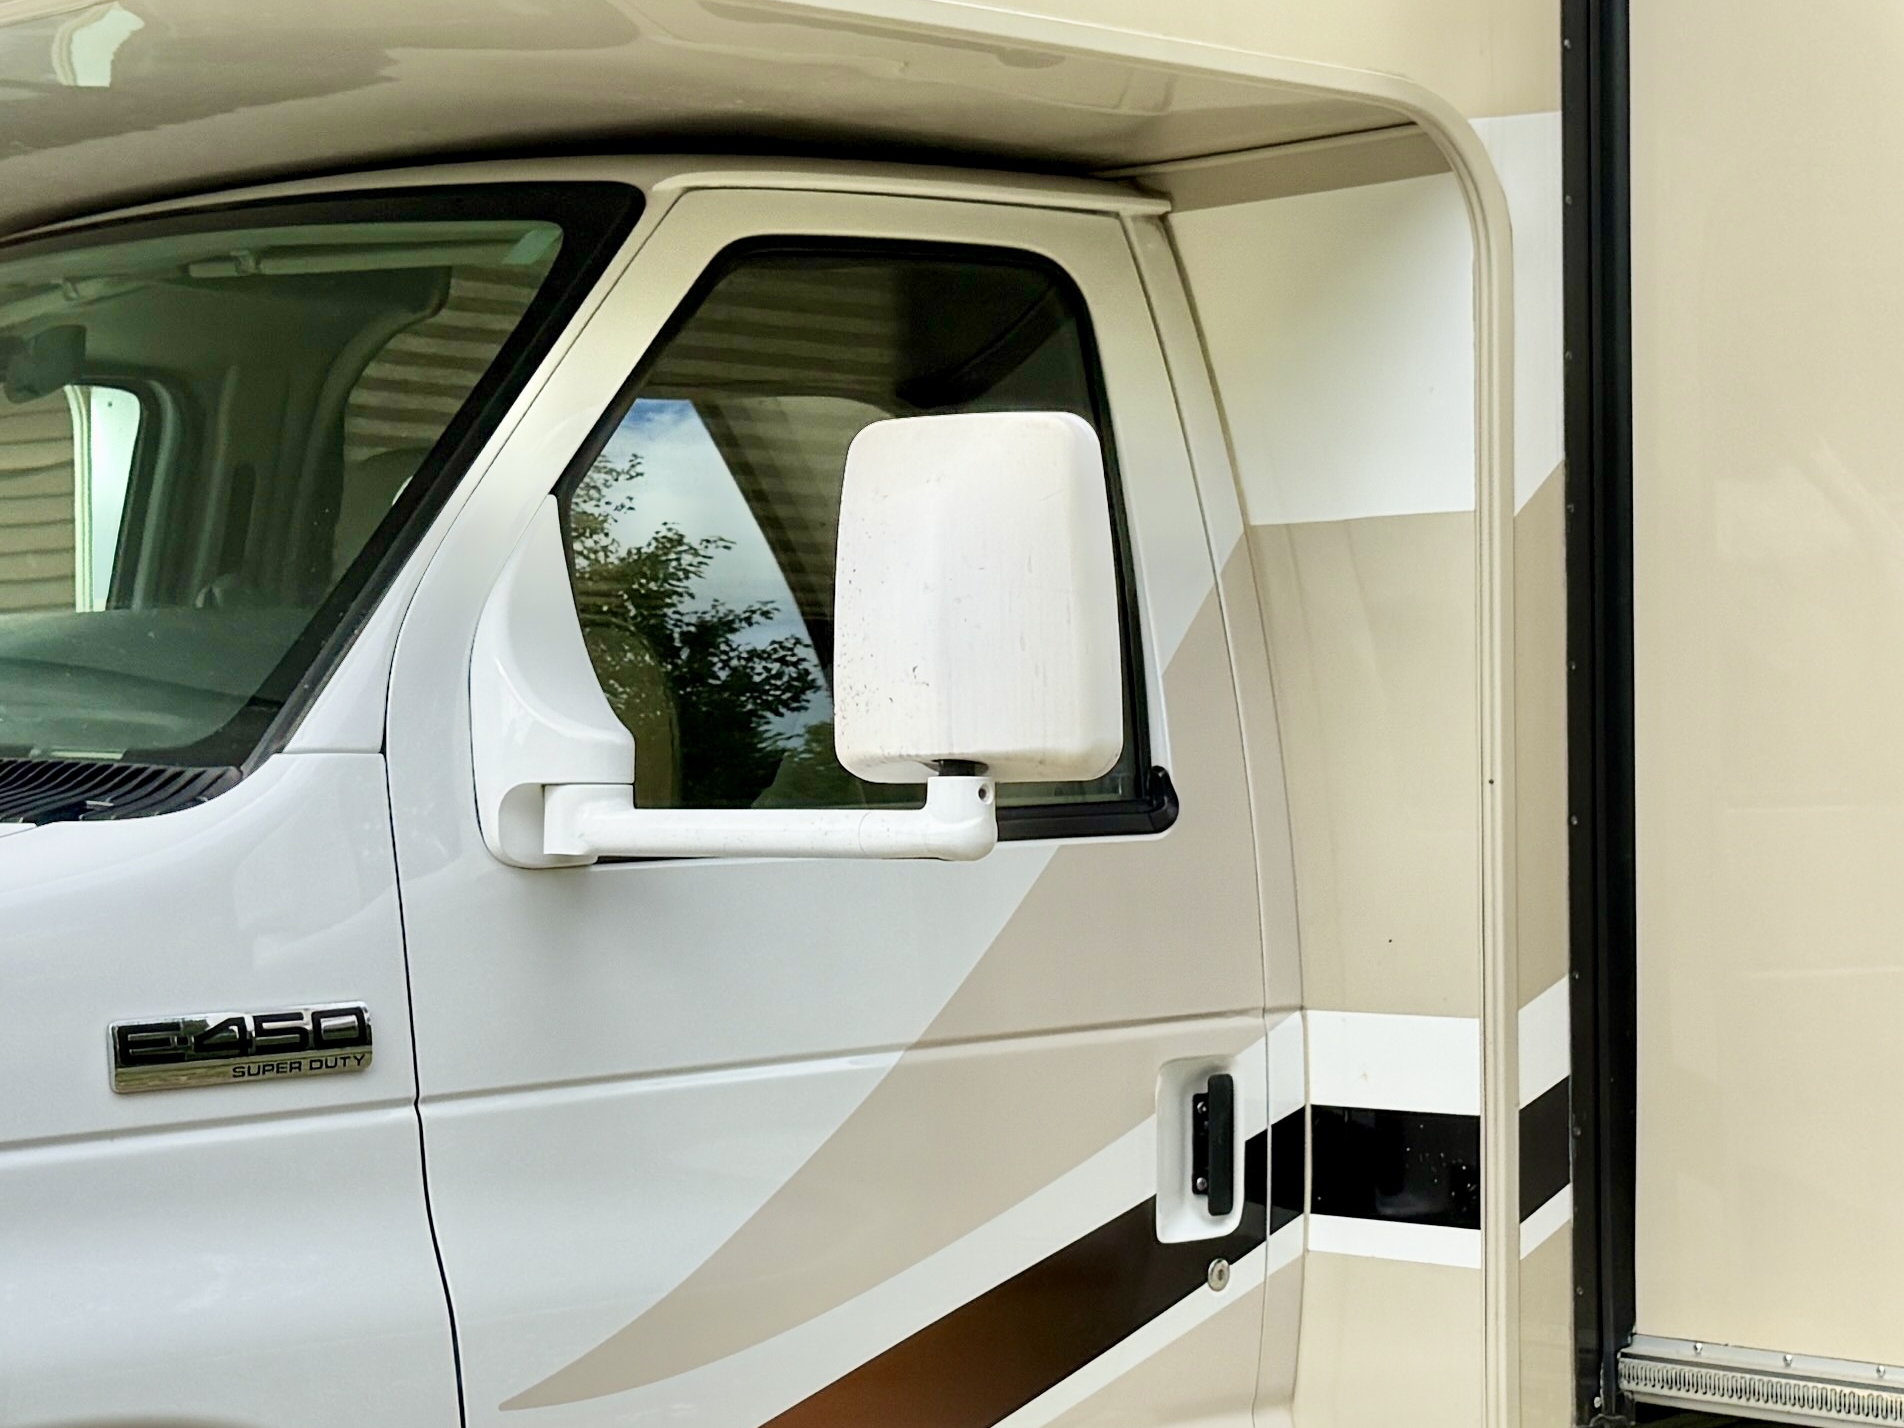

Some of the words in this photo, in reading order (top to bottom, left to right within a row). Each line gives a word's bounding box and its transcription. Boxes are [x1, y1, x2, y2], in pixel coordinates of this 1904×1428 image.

[117, 1006, 372, 1066] E-450
[232, 1060, 302, 1079] SUPER
[309, 1053, 366, 1070] DUTY
